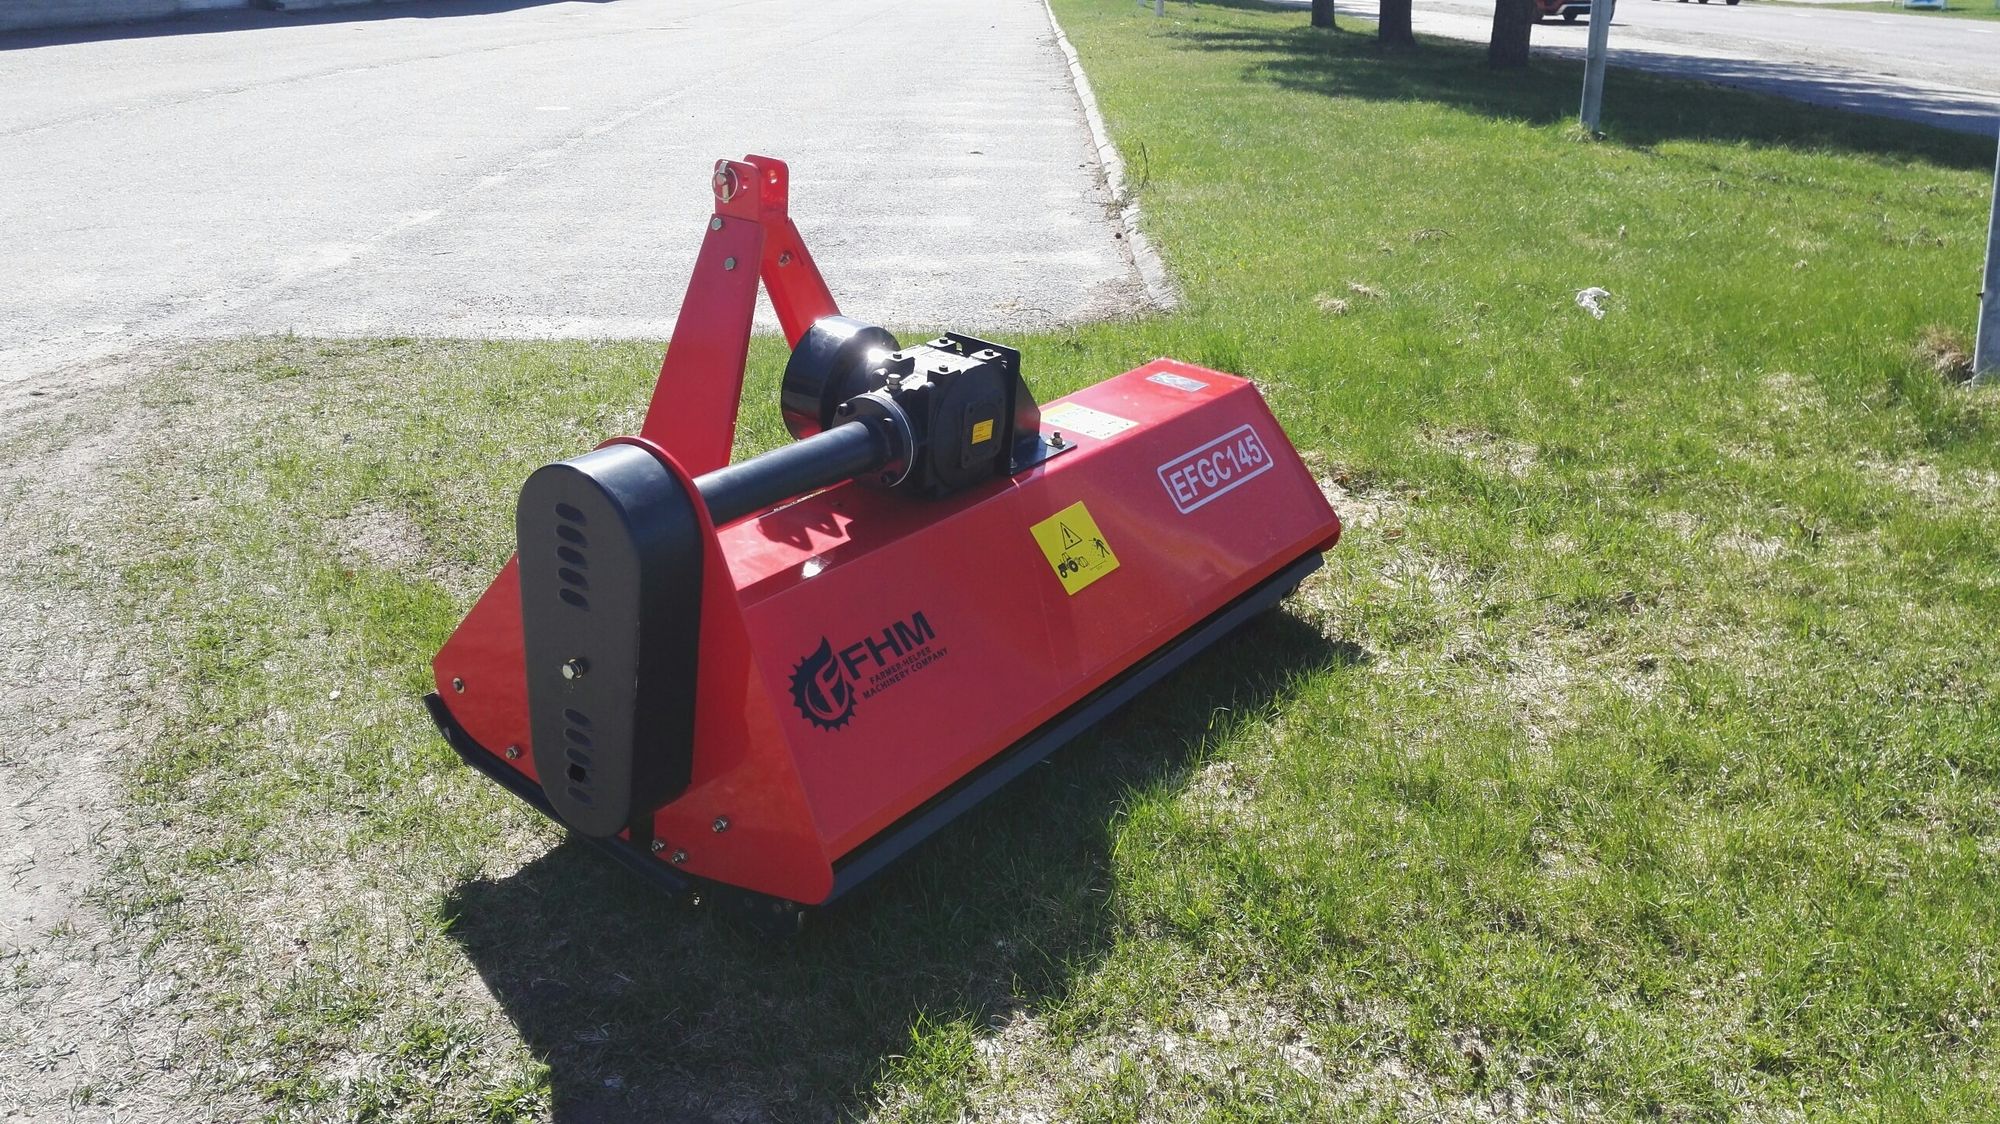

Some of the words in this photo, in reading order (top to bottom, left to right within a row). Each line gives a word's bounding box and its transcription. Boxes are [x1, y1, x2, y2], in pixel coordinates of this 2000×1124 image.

[1169, 435, 1262, 503] EFGC145
[839, 610, 935, 680] FHM
[863, 669, 910, 699] MACHINERY
[911, 648, 949, 672] COMPANY
